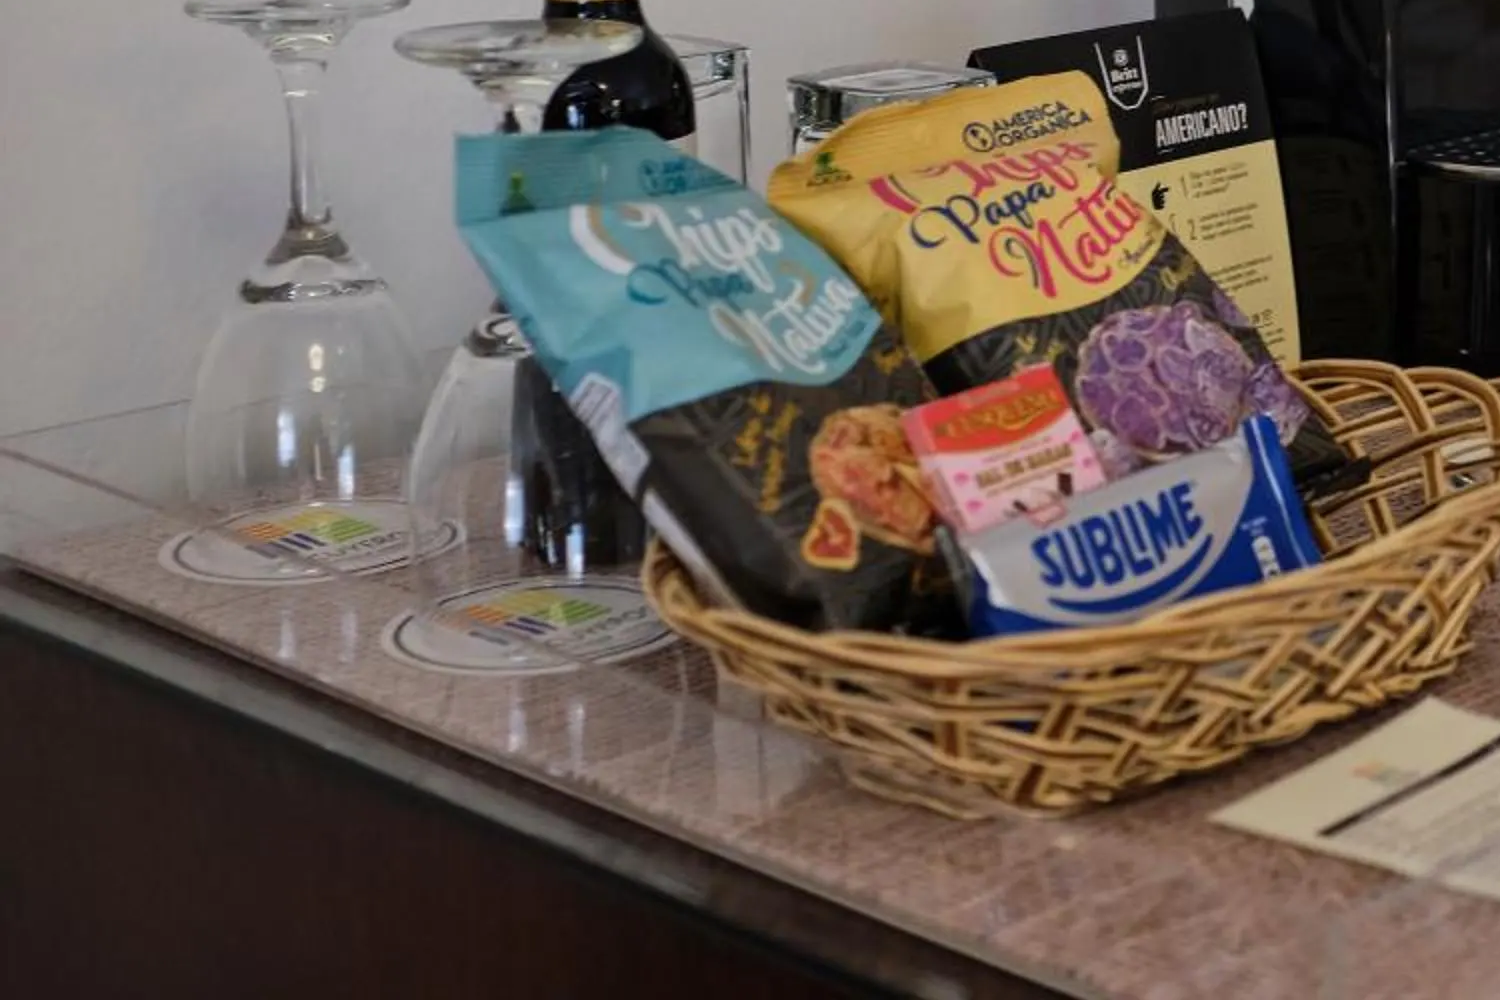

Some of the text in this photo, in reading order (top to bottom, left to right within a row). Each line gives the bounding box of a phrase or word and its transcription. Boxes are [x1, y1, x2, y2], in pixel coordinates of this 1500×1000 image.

[992, 100, 1070, 132] AMERICA
[996, 109, 1092, 148] ORGANICA
[1155, 102, 1248, 148] AMERICANO?
[909, 181, 1056, 249] Papa
[1031, 480, 1204, 590] SUBLIME
